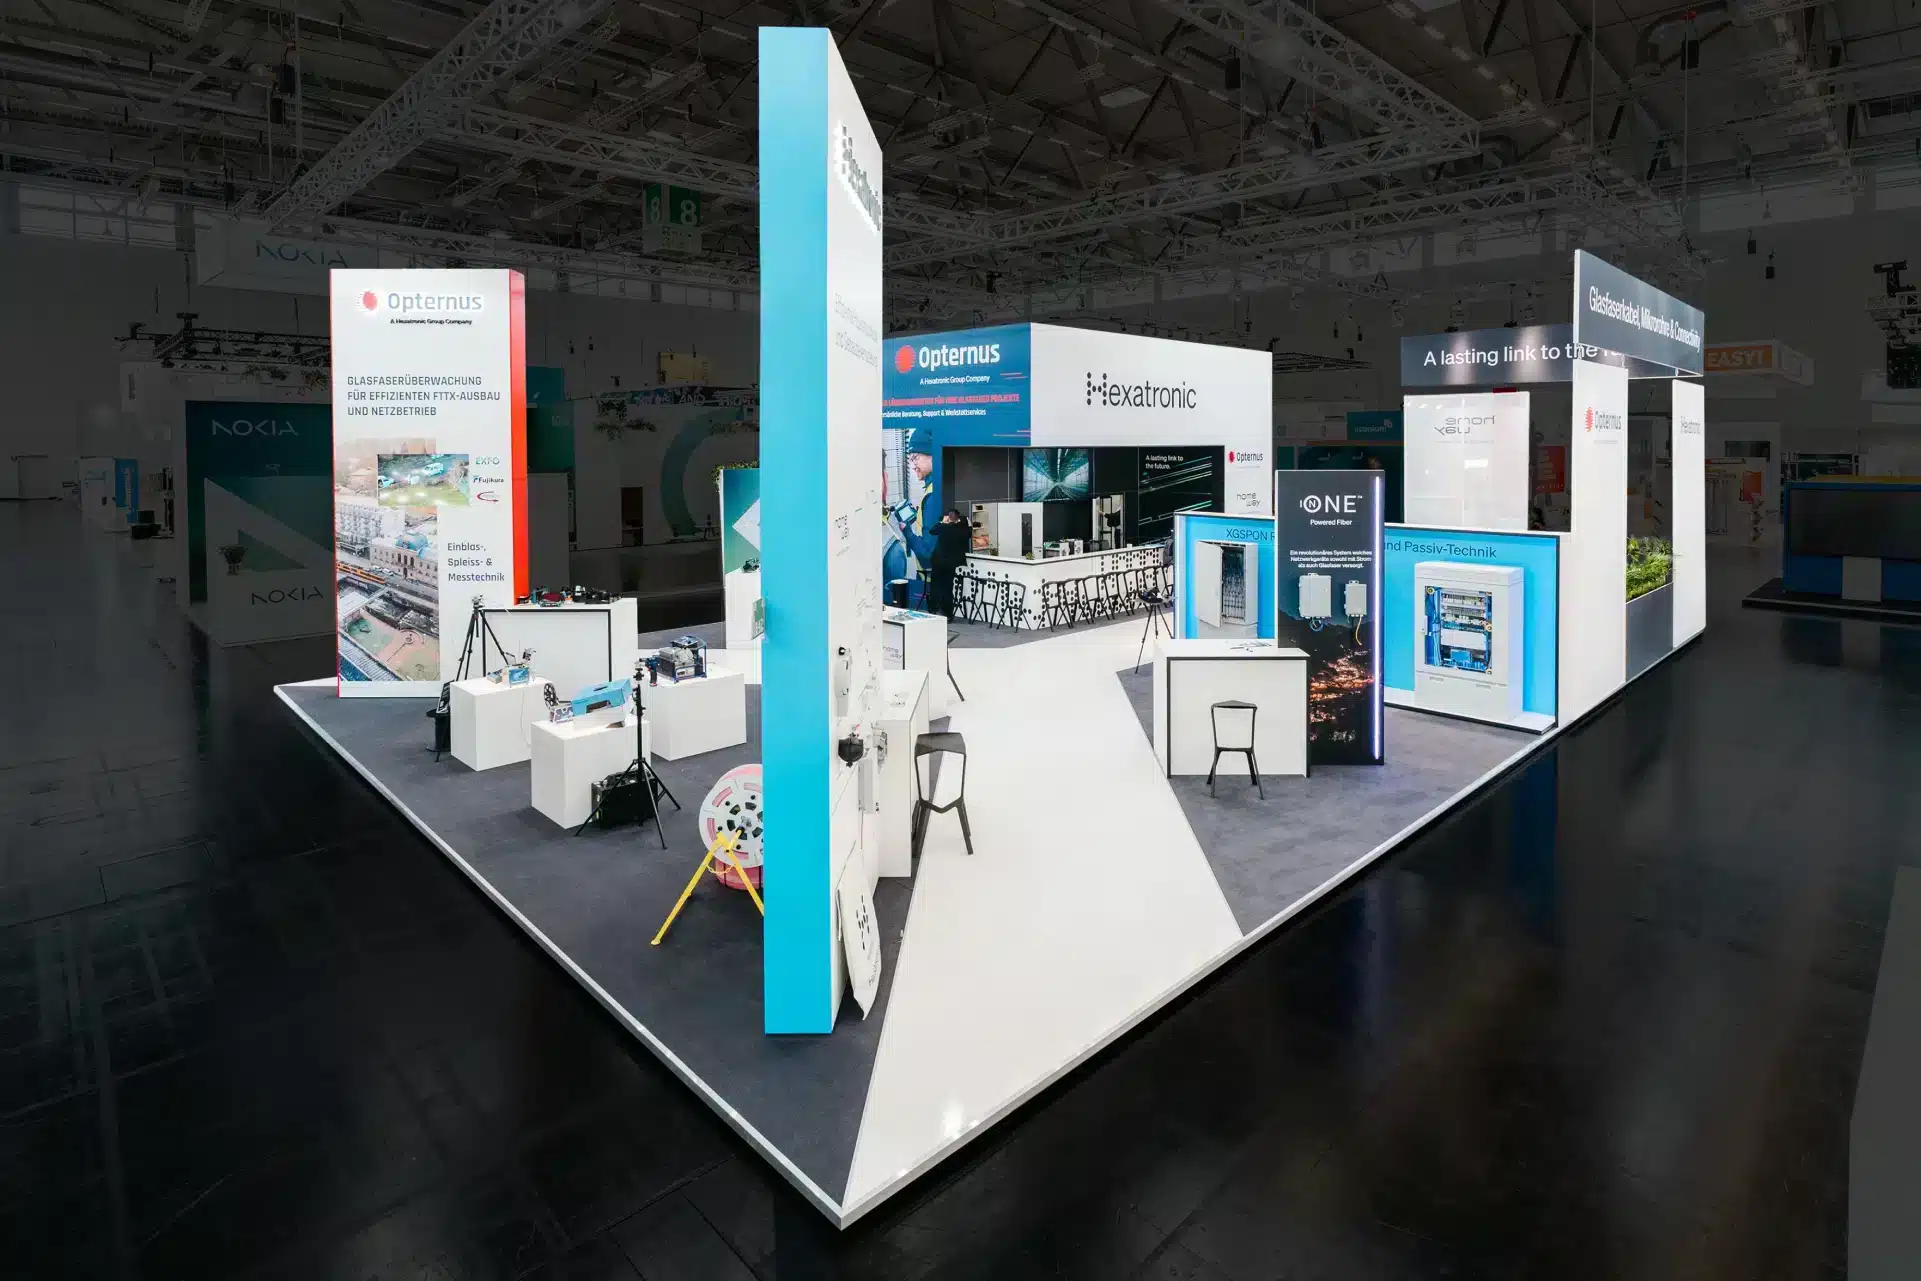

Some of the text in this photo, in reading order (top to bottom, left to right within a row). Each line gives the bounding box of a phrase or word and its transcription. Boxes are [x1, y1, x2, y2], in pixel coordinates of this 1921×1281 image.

[681, 199, 698, 225] 8
[388, 292, 483, 313] Opternus
[1589, 285, 1641, 330] Glasfaserkabel,
[1674, 321, 1701, 354] Connectivity
[919, 344, 1000, 371] Opternus
[1423, 351, 1437, 367] A
[1440, 347, 1499, 367] lasting
[1503, 346, 1537, 362] link
[1540, 344, 1560, 360] to
[1564, 343, 1599, 359] the
[347, 373, 483, 386] GLASFASERÜBERWACHUNG
[949, 376, 965, 384] Group
[965, 374, 991, 383] Company
[347, 388, 501, 401] FÜR EFFIZIENTEN FTTX-AUSBAU
[1086, 372, 1197, 410] Hexatronic
[347, 406, 437, 416] UND NETZBETRIEB
[211, 419, 299, 437] NOKIA
[1150, 455, 1168, 463] lasting
[1236, 451, 1263, 463] Opternus
[1154, 463, 1171, 471] future.
[478, 476, 505, 484] Fujikura
[1226, 528, 1268, 541] XGSPON
[1384, 540, 1497, 559] nd Passiv-Technik
[447, 558, 493, 568] Spleiss- &
[448, 572, 505, 582] Messtechnik
[251, 586, 324, 606] NOKIA
